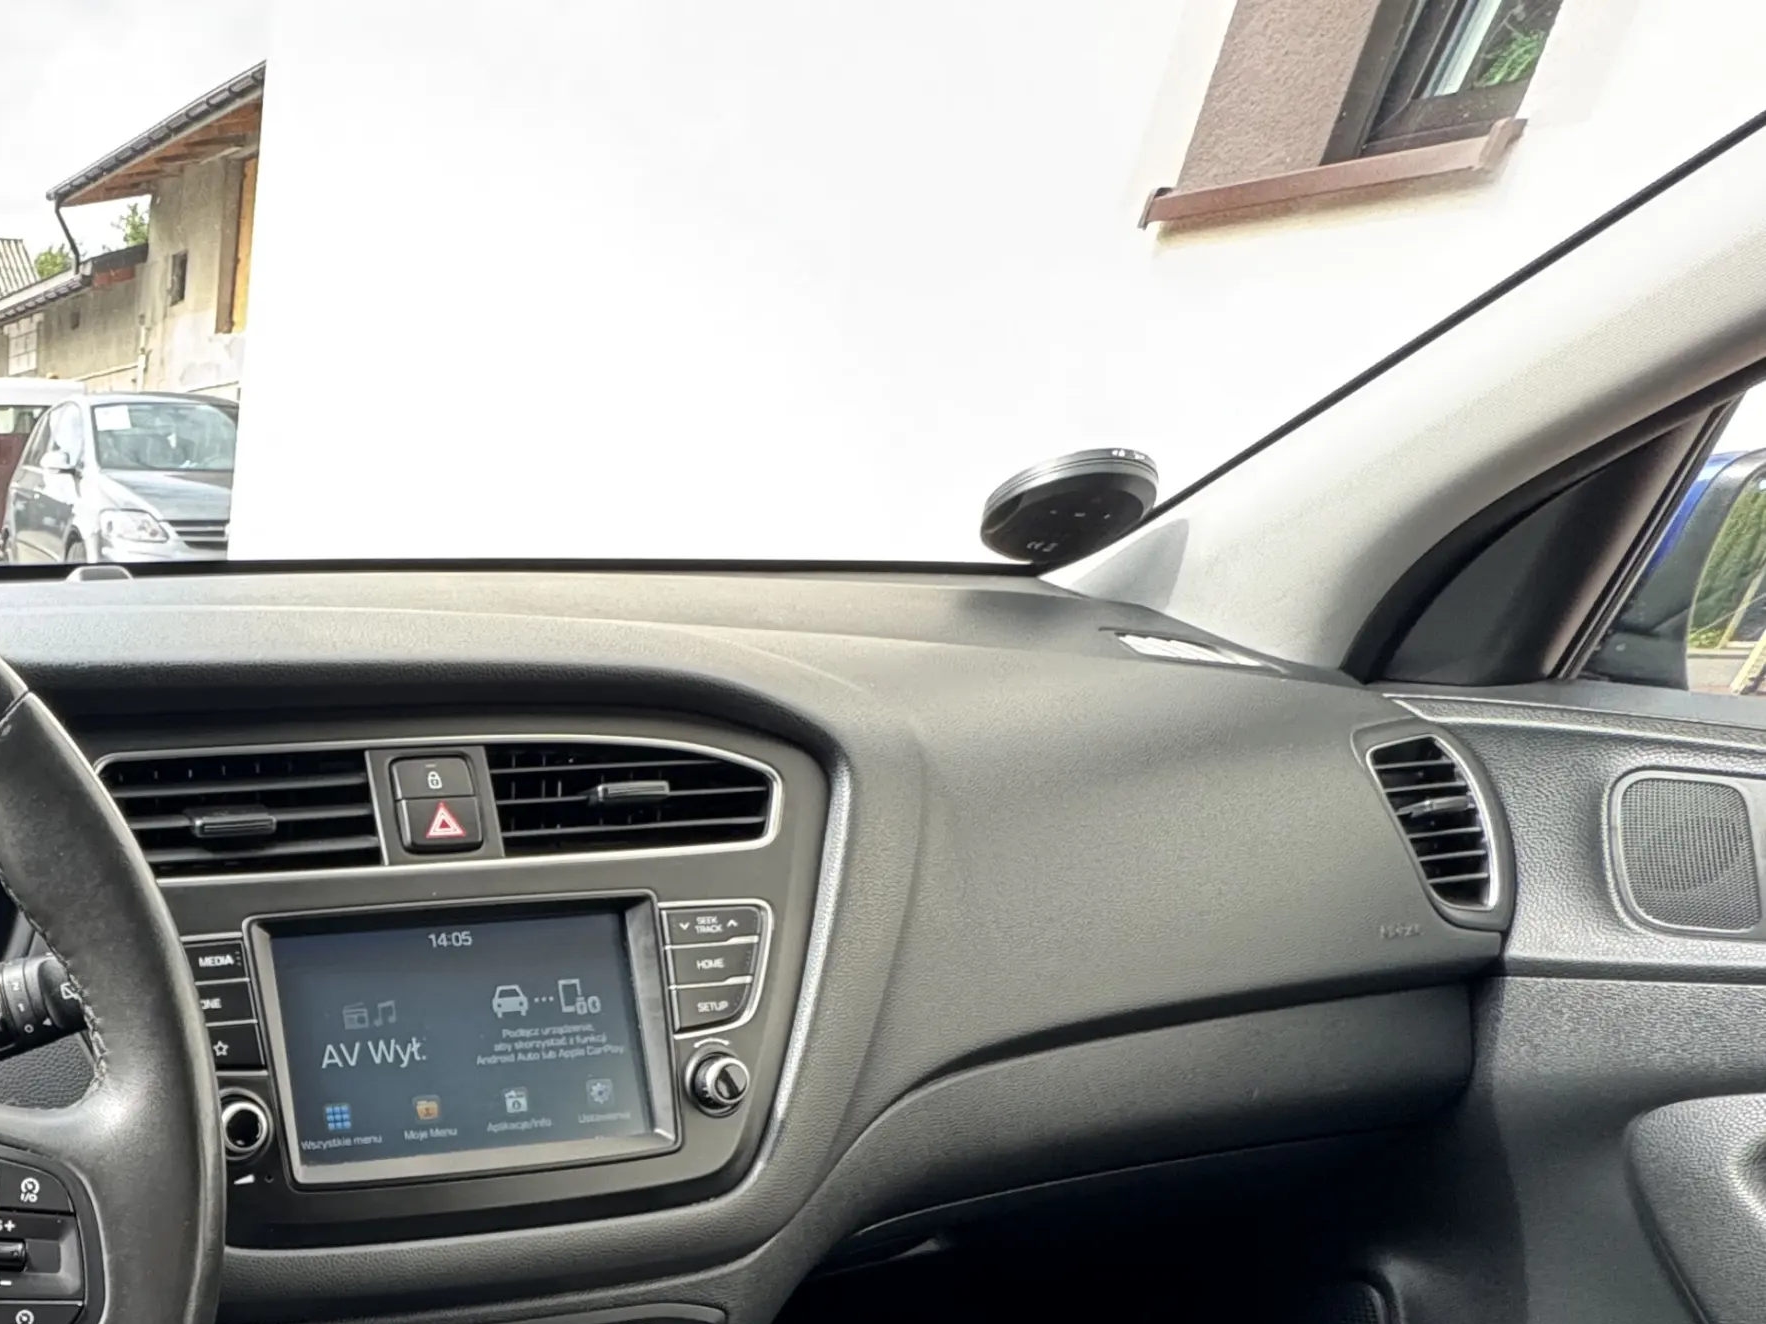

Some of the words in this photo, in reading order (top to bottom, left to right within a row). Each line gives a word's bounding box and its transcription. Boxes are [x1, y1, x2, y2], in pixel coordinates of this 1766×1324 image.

[428, 931, 473, 948] 14:05
[198, 954, 234, 967] MEDIA
[696, 958, 725, 970] HOME
[697, 1000, 729, 1012] SETUP
[321, 1041, 361, 1069] AV
[367, 1036, 427, 1069] Wył.
[353, 1134, 383, 1145] menu
